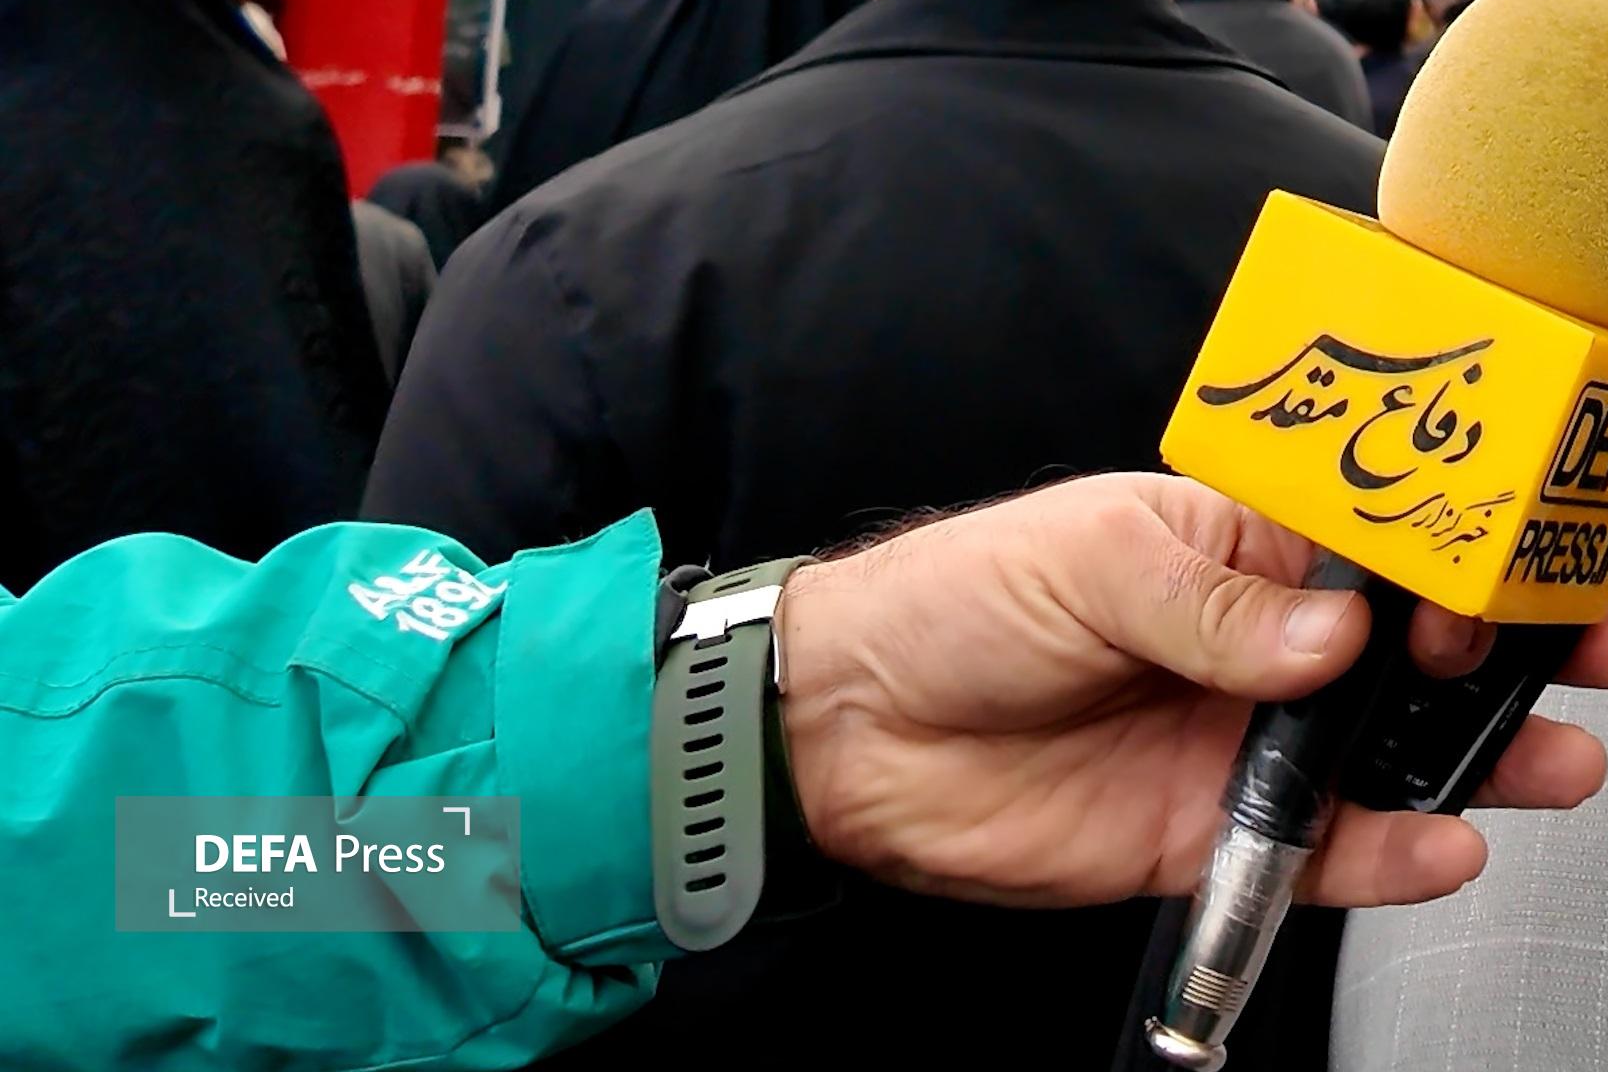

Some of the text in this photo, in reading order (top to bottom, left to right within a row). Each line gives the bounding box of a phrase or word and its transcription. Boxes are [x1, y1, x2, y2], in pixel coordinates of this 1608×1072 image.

[1196, 334, 1495, 491] دفاع مقدس
[1352, 492, 1516, 565] خبرگزاری
